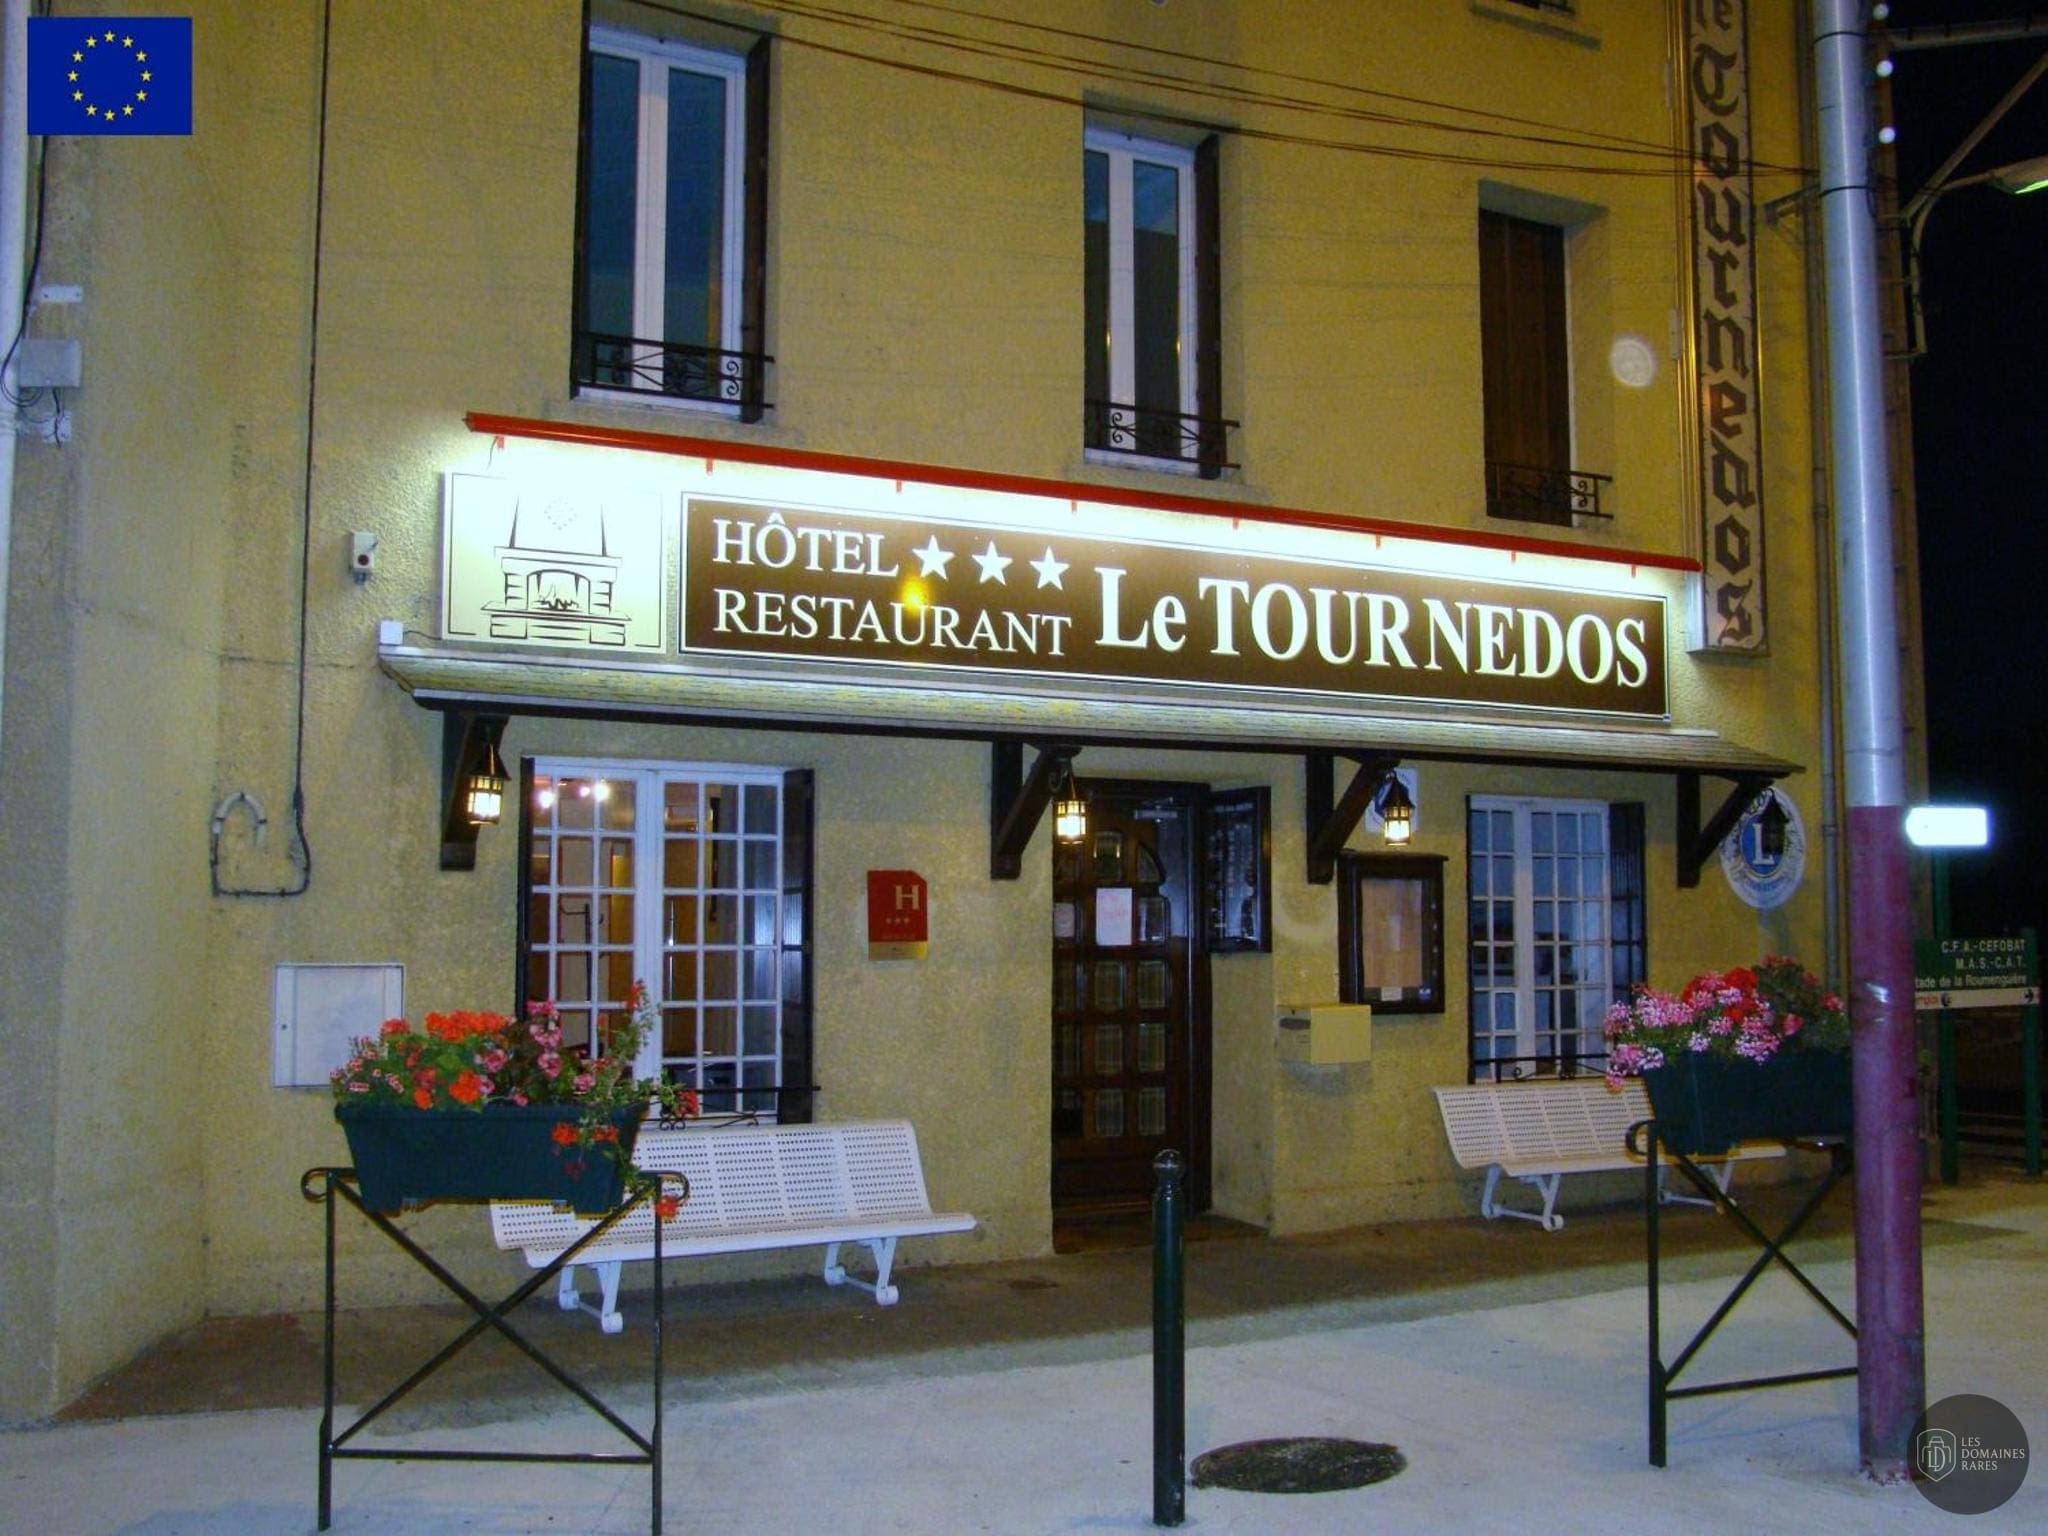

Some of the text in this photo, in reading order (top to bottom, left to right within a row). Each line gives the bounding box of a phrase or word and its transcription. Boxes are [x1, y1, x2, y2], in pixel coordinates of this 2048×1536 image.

[712, 512, 899, 578] HÔTEL
[712, 588, 1072, 657] RESTAURANT
[1094, 566, 1648, 688] Le TOURNEDOS
[1752, 823, 1776, 866] L
[895, 884, 920, 910] H
[1914, 975, 1937, 990] tade
